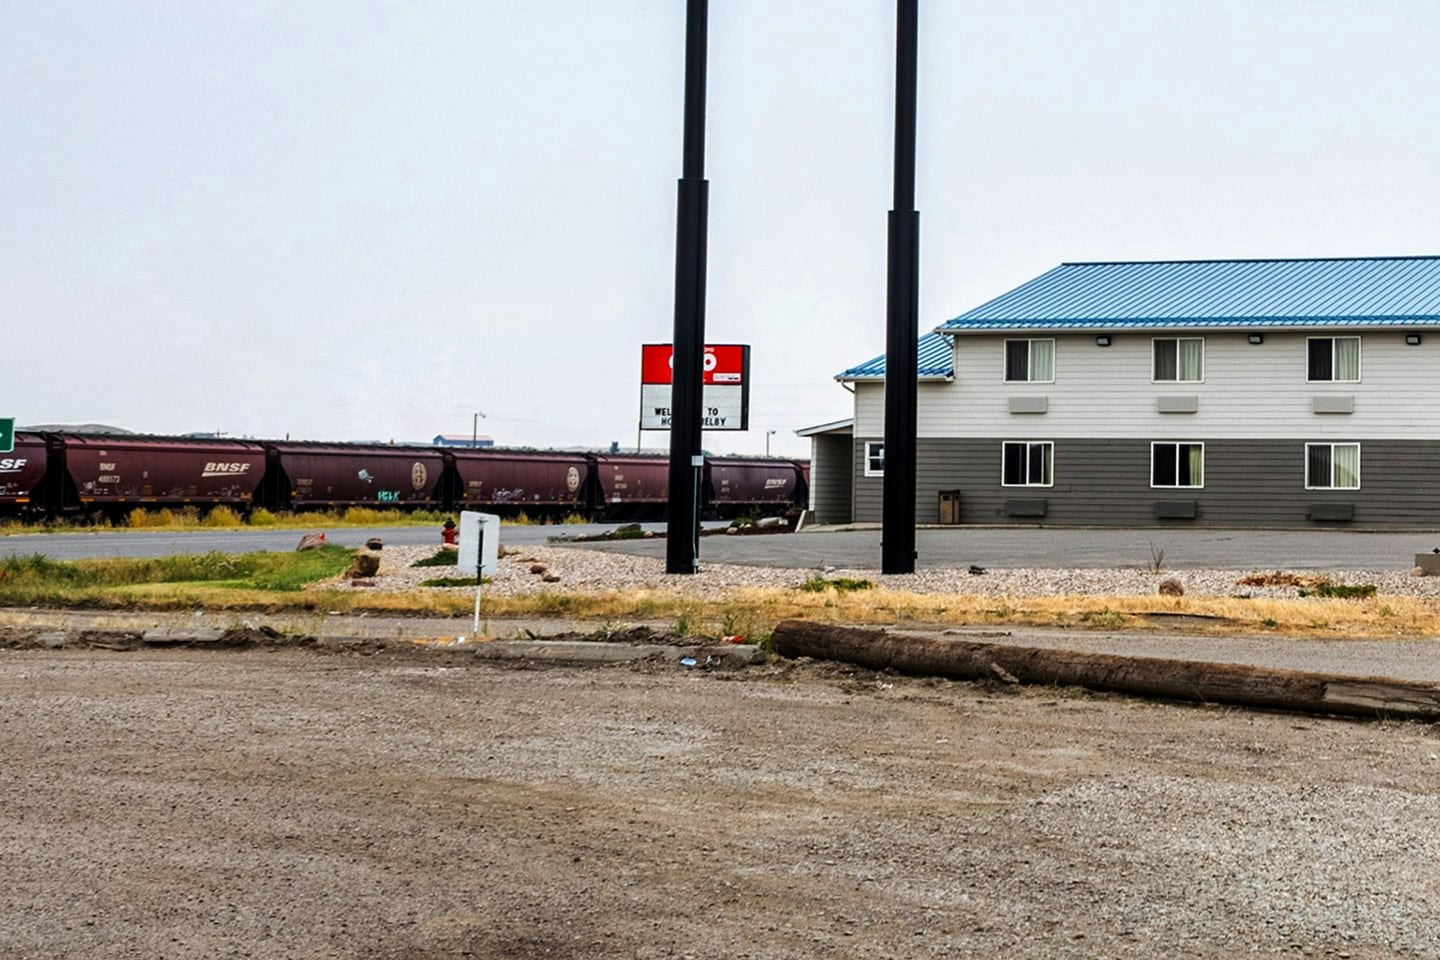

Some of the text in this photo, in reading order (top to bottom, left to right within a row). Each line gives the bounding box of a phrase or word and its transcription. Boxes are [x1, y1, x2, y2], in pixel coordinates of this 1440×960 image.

[707, 407, 719, 416] TO
[702, 417, 727, 426] ELBY
[204, 462, 251, 472] BNSF
